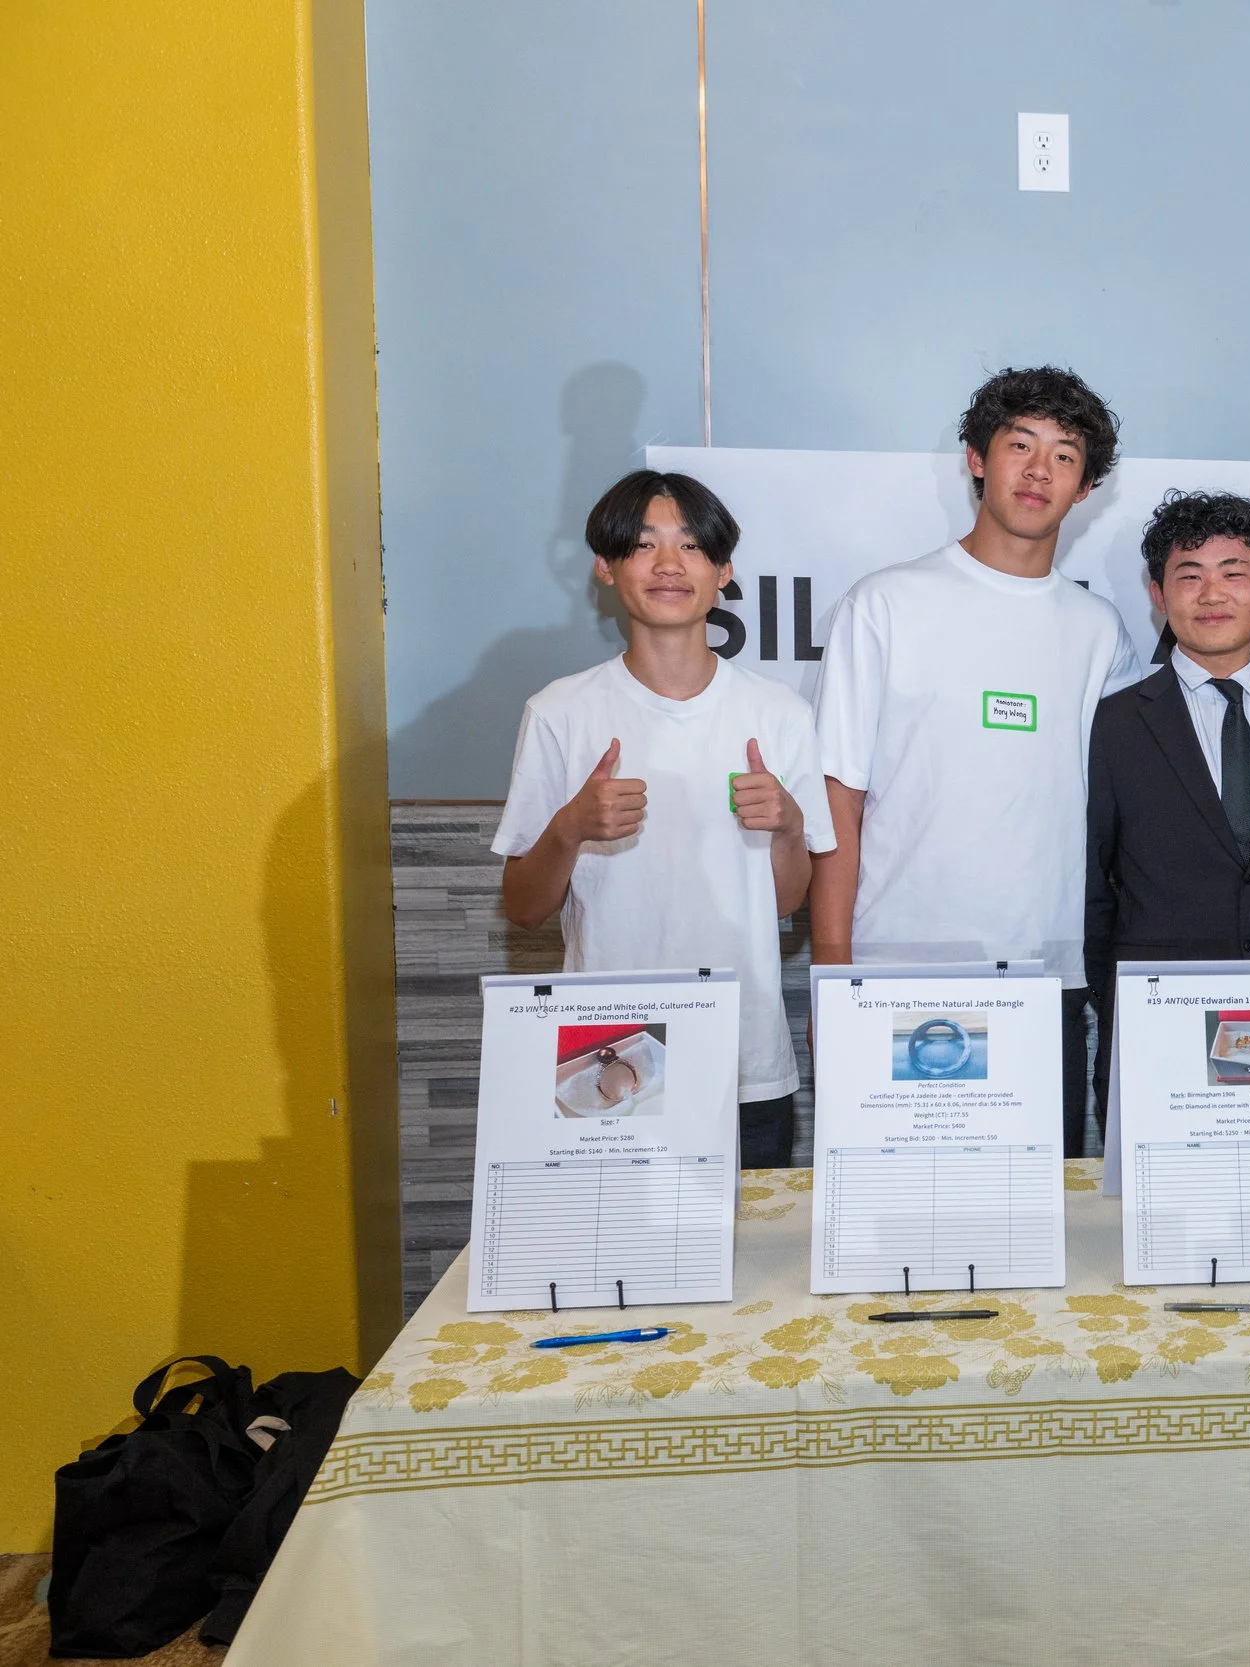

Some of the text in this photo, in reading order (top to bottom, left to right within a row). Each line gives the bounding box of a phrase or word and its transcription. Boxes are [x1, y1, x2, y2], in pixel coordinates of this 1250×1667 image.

[875, 1001, 911, 1010] Yin-Yang
[996, 1000, 1024, 1009] Bangle
[1165, 997, 1199, 1005] ANTIQUE
[638, 1003, 658, 1011] Gold,
[632, 1012, 649, 1021] Ring
